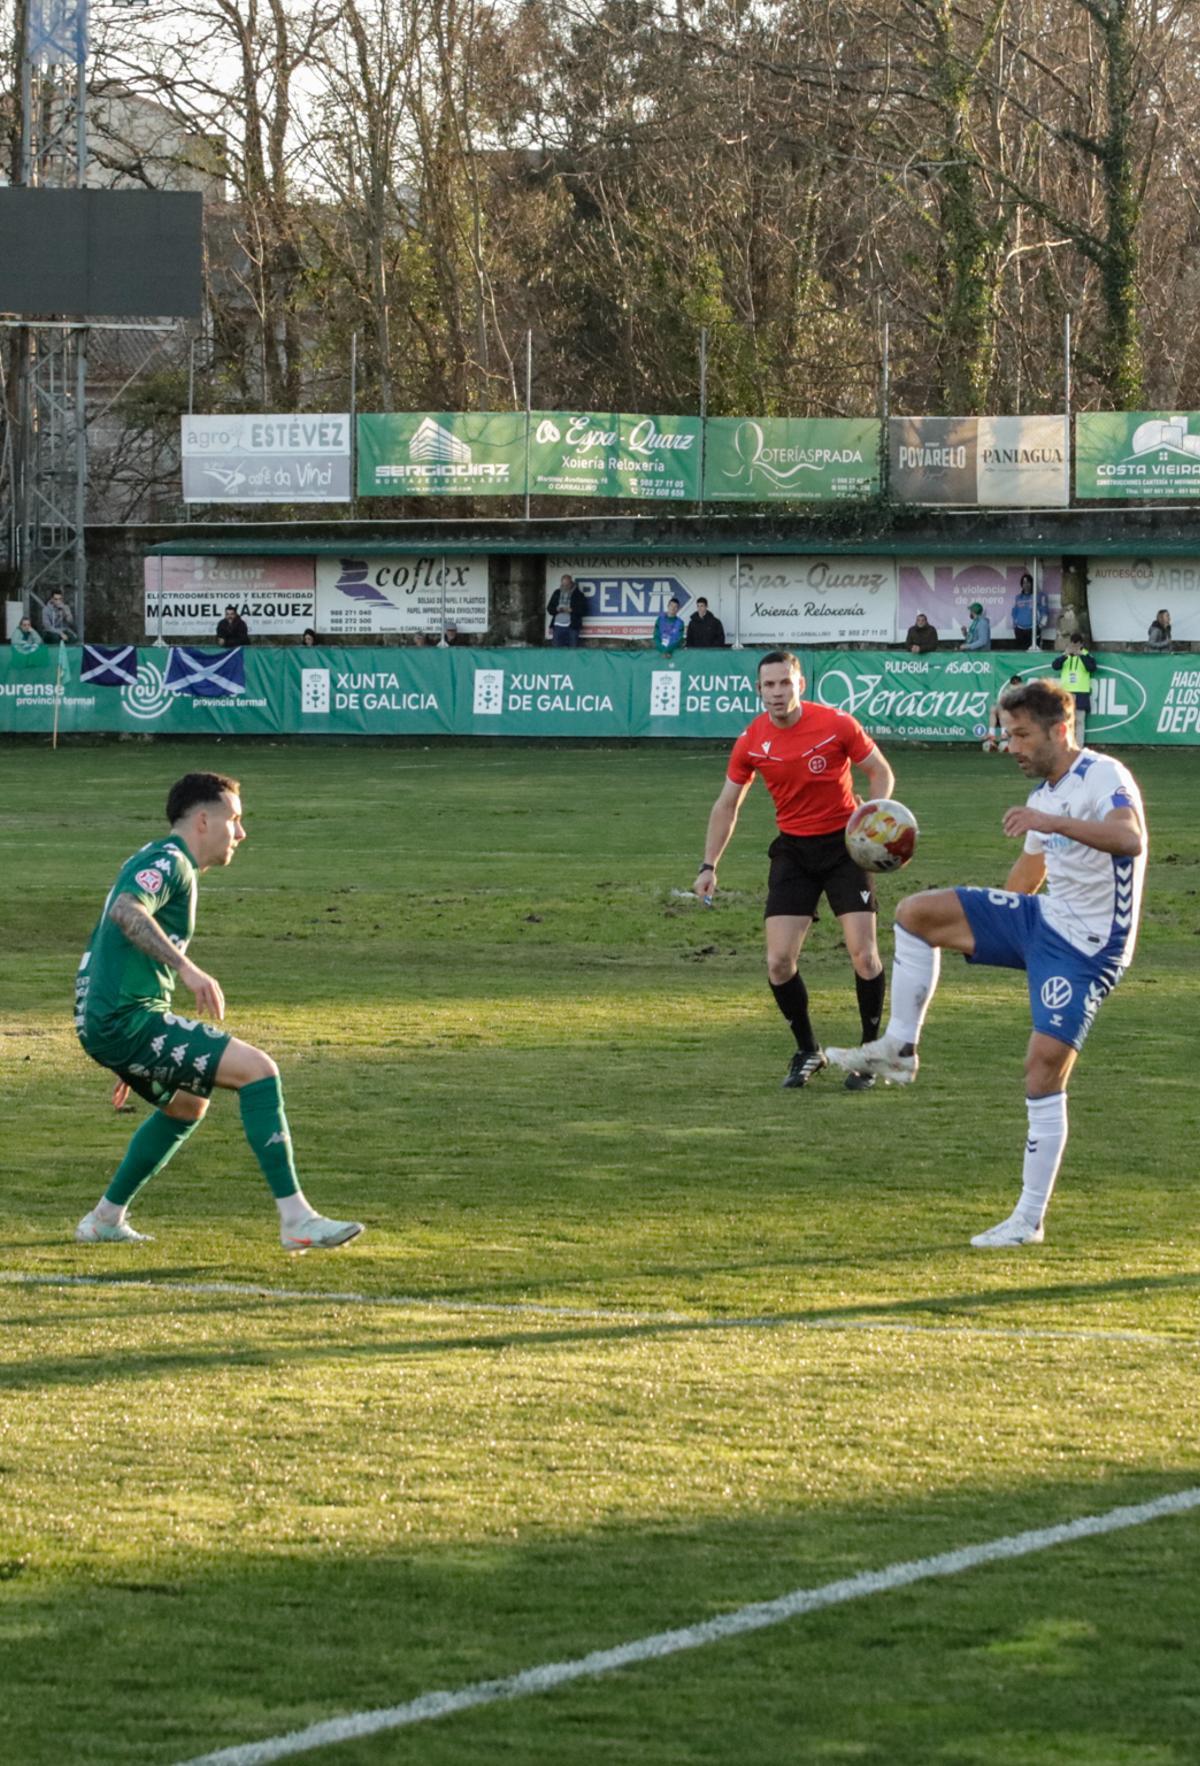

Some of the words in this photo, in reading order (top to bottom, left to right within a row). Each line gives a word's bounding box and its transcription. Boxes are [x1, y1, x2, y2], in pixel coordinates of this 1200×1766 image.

[187, 431, 230, 448] agro
[251, 418, 343, 447] ESTÉVEZ
[983, 448, 1062, 463] PANIAGUA
[608, 457, 665, 472] Reloxería
[1096, 464, 1147, 476] COSTA
[375, 557, 470, 594] coflex
[577, 581, 674, 613] PEÑA
[961, 584, 1006, 594] violencia
[146, 603, 222, 618] MANUEL
[804, 601, 866, 616] Reloxería
[945, 661, 990, 674] ASADOR
[337, 673, 400, 689] XUNTA
[511, 674, 574, 690] XUNTA
[688, 675, 752, 692] XUNTA
[16, 696, 61, 707] provincia
[63, 696, 96, 705] termal
[335, 694, 360, 710] DE
[363, 694, 439, 710] GALICIA
[818, 670, 989, 718] Veracruz
[1164, 688, 1174, 705] A
[1176, 688, 1200, 705] LOS
[192, 698, 235, 708] provincia
[237, 698, 267, 707] termal
[508, 695, 533, 711] DE
[537, 695, 614, 712] GALICIA
[686, 696, 711, 713] DE
[715, 697, 767, 713] GALI
[907, 725, 967, 736] CARBALLIÑO
